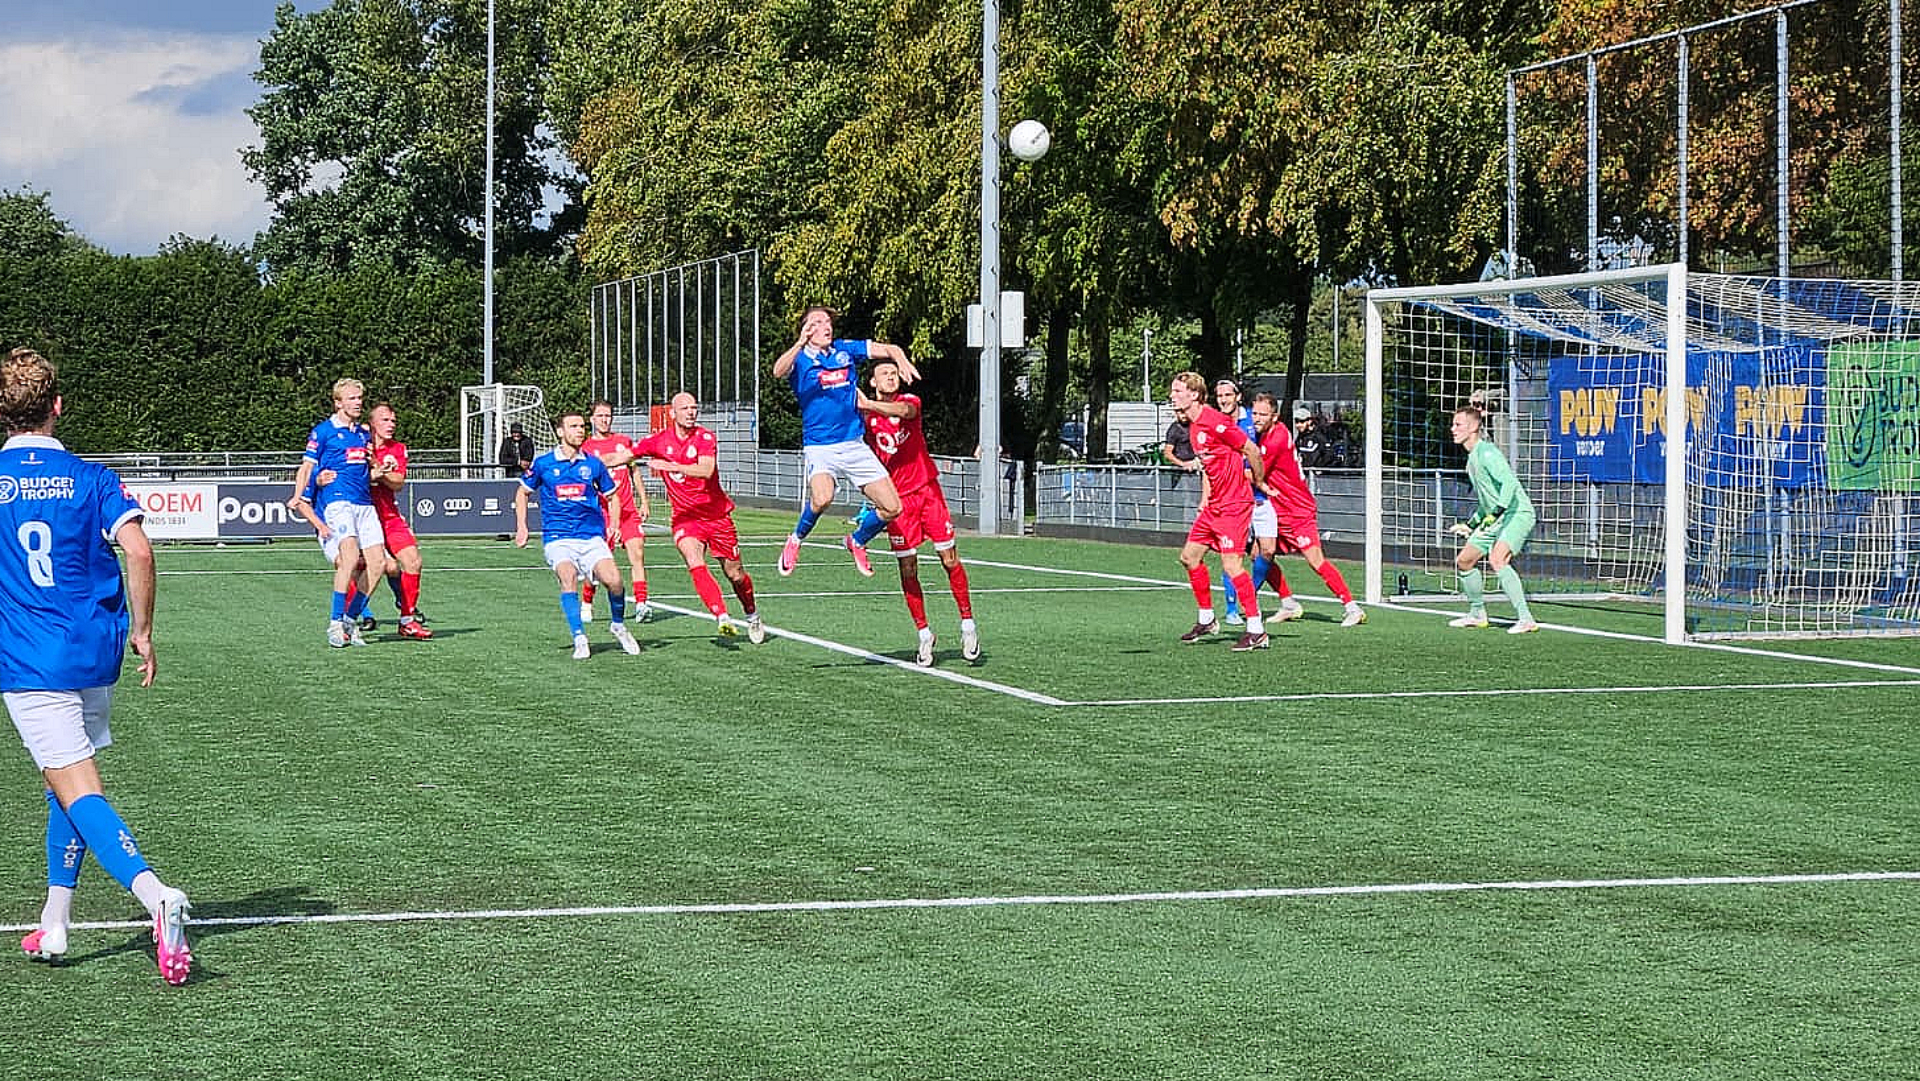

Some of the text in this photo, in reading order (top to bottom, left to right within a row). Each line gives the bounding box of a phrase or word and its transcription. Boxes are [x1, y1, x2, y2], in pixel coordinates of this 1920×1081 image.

[20, 477, 75, 489] BUDGET
[21, 489, 75, 501] TROPHY
[17, 520, 55, 587] 8
